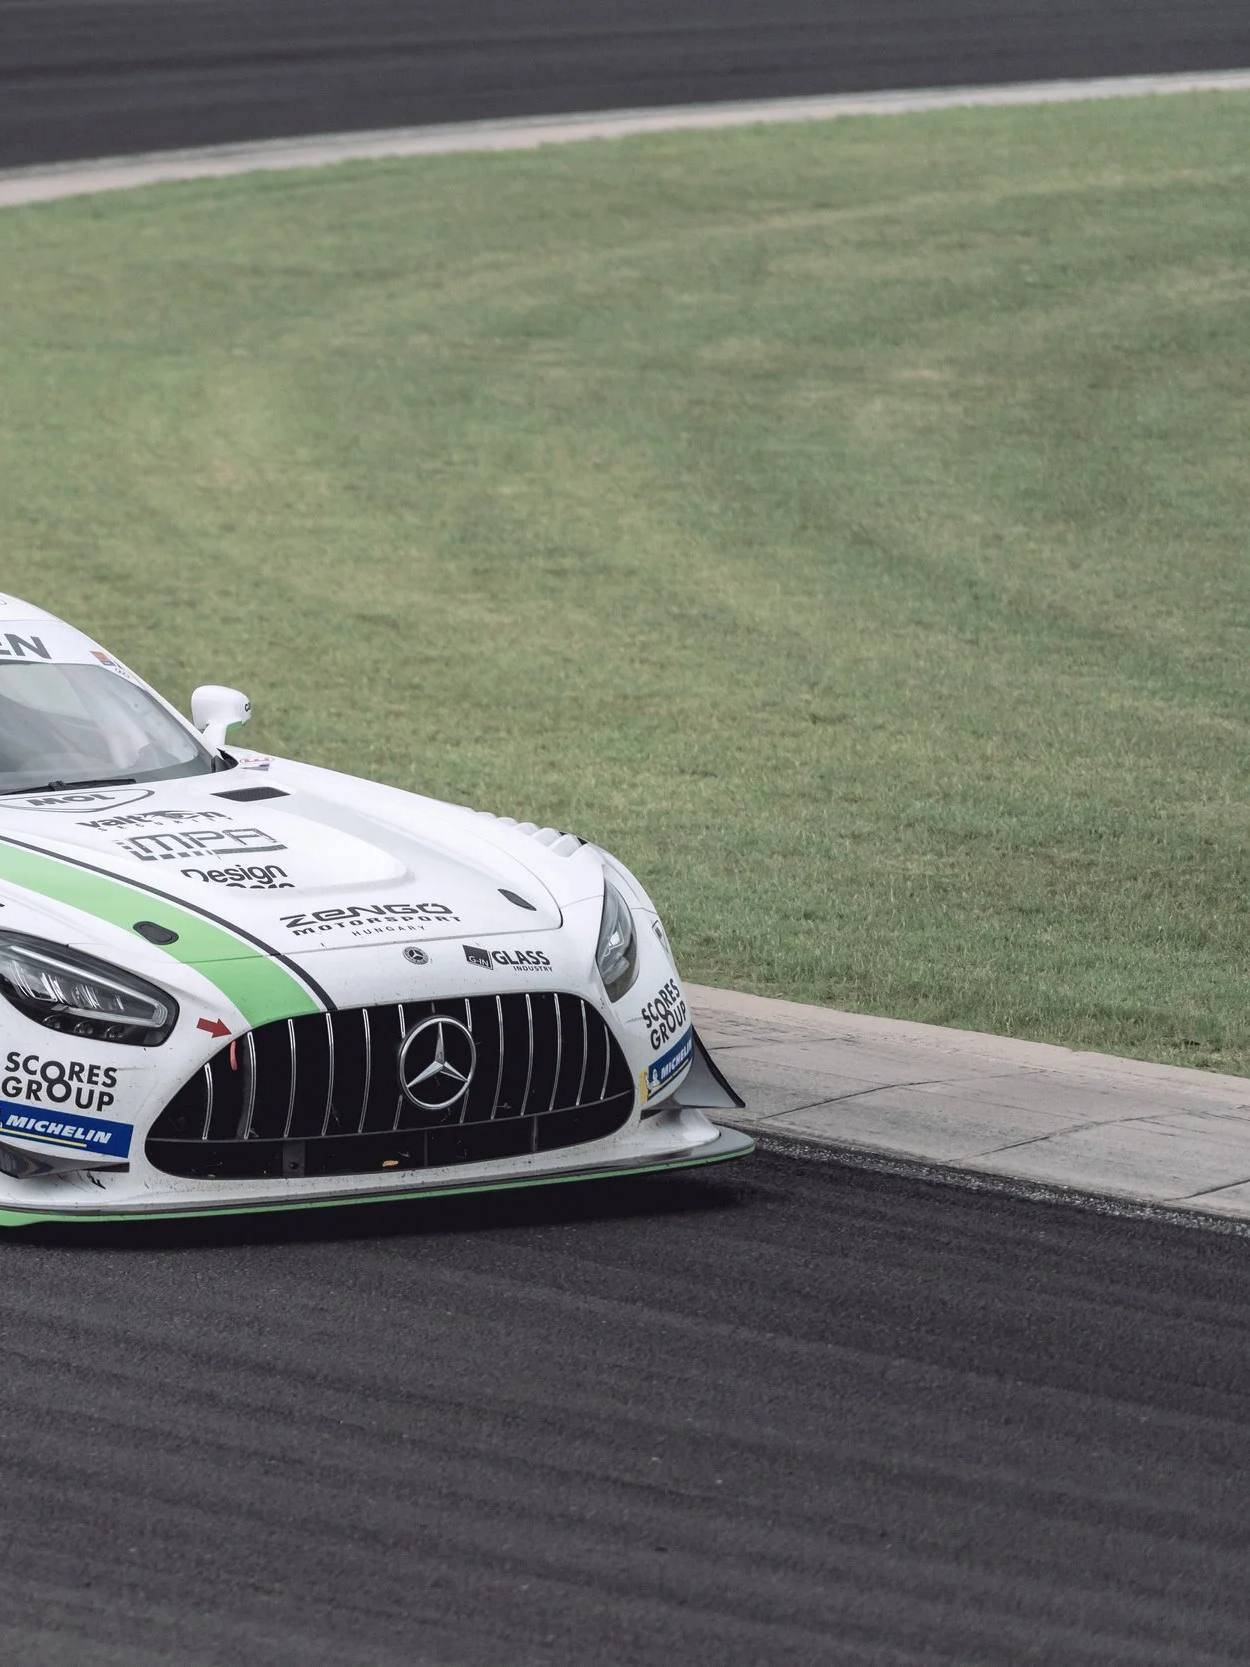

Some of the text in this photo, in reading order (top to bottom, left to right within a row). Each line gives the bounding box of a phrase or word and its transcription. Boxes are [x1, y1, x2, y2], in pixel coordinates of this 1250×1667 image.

[26, 793, 116, 807] MOL
[292, 915, 463, 936] MOTORSPORT
[351, 924, 427, 937] HUNGARY
[491, 950, 551, 966] GLASS
[512, 965, 553, 973] INDUSTRY
[641, 978, 681, 1029] SCORES
[650, 1000, 687, 1050] GROUP
[4, 1051, 118, 1088] SCORES
[660, 1039, 692, 1080] MICHELIN
[1, 1076, 115, 1112] GROUP
[6, 1114, 112, 1144] MICHELIN
